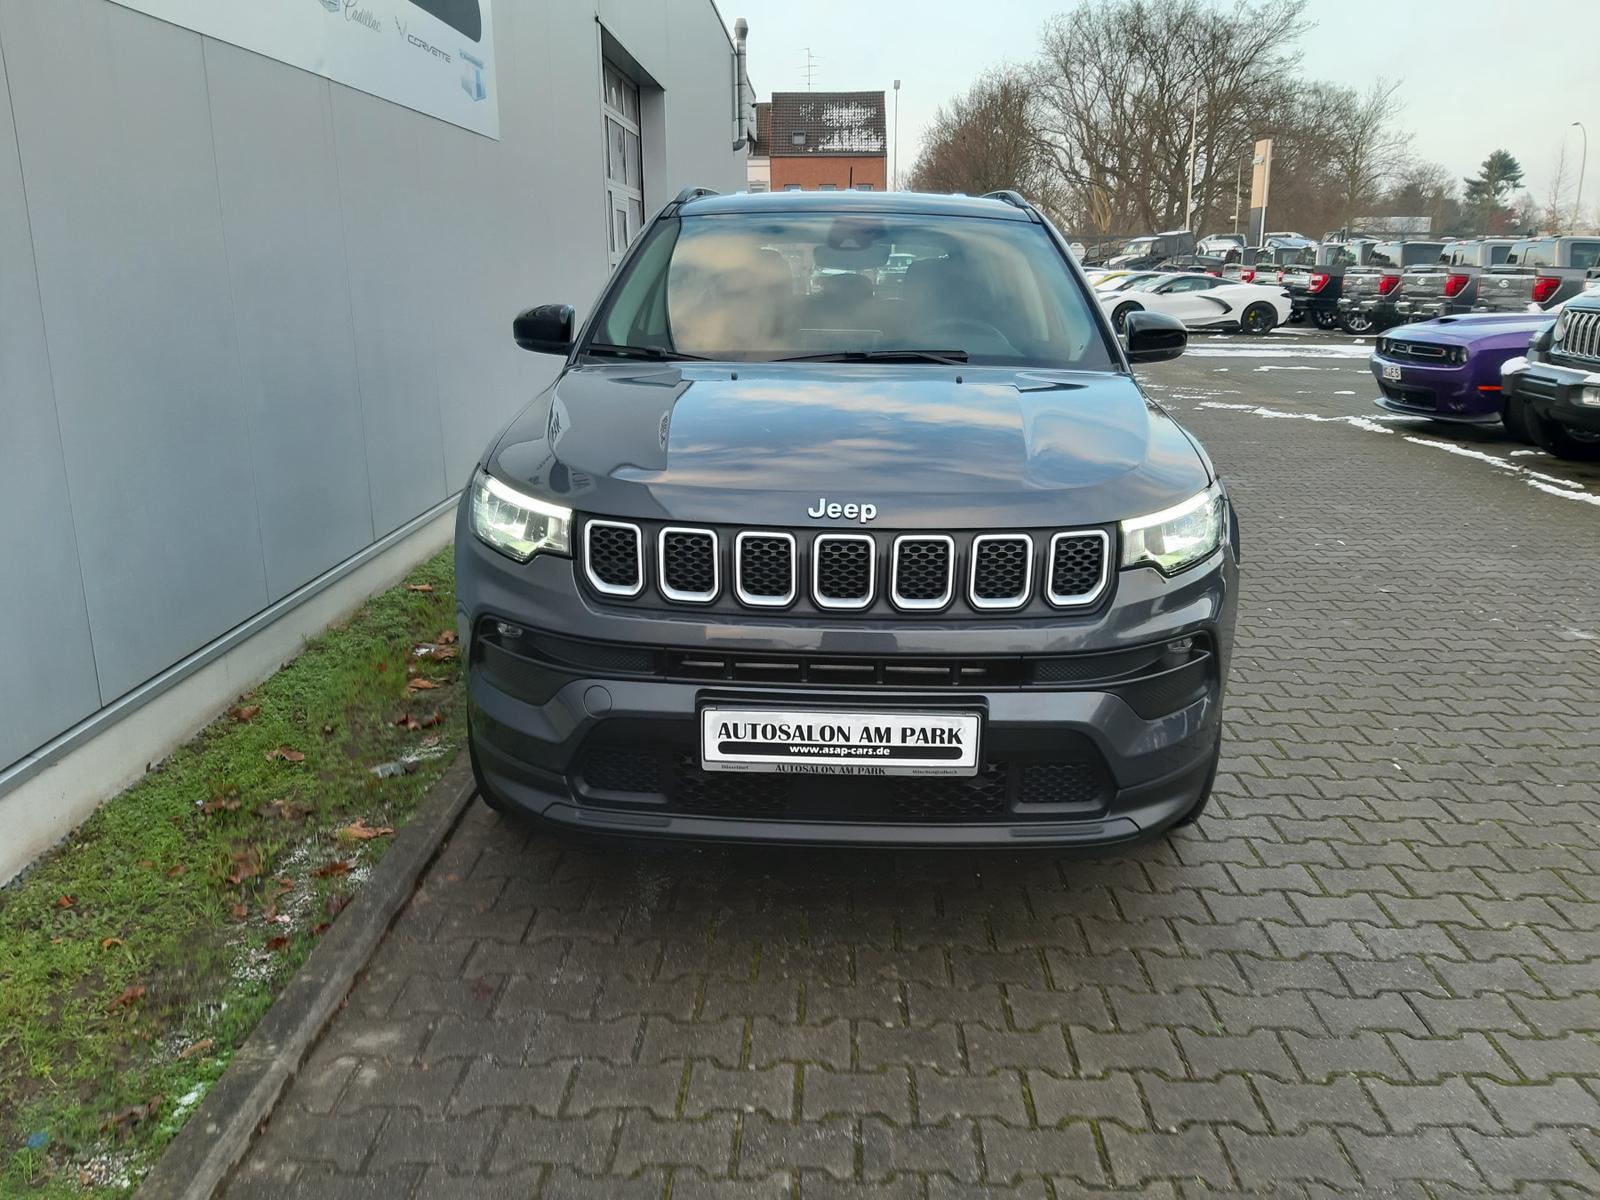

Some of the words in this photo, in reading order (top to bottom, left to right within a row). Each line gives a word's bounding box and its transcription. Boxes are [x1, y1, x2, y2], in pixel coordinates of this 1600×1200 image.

[343, 0, 382, 33] Cadillac
[407, 34, 451, 63] CORVETTE
[807, 497, 877, 523] Jeep
[718, 722, 850, 743] AUTOSALON
[859, 726, 892, 743] AM
[901, 727, 963, 744] PARK
[789, 745, 891, 757] www.asap-cars.de
[775, 764, 836, 774] AUTOSALON
[838, 766, 854, 775] AM
[857, 767, 886, 776] PARK
